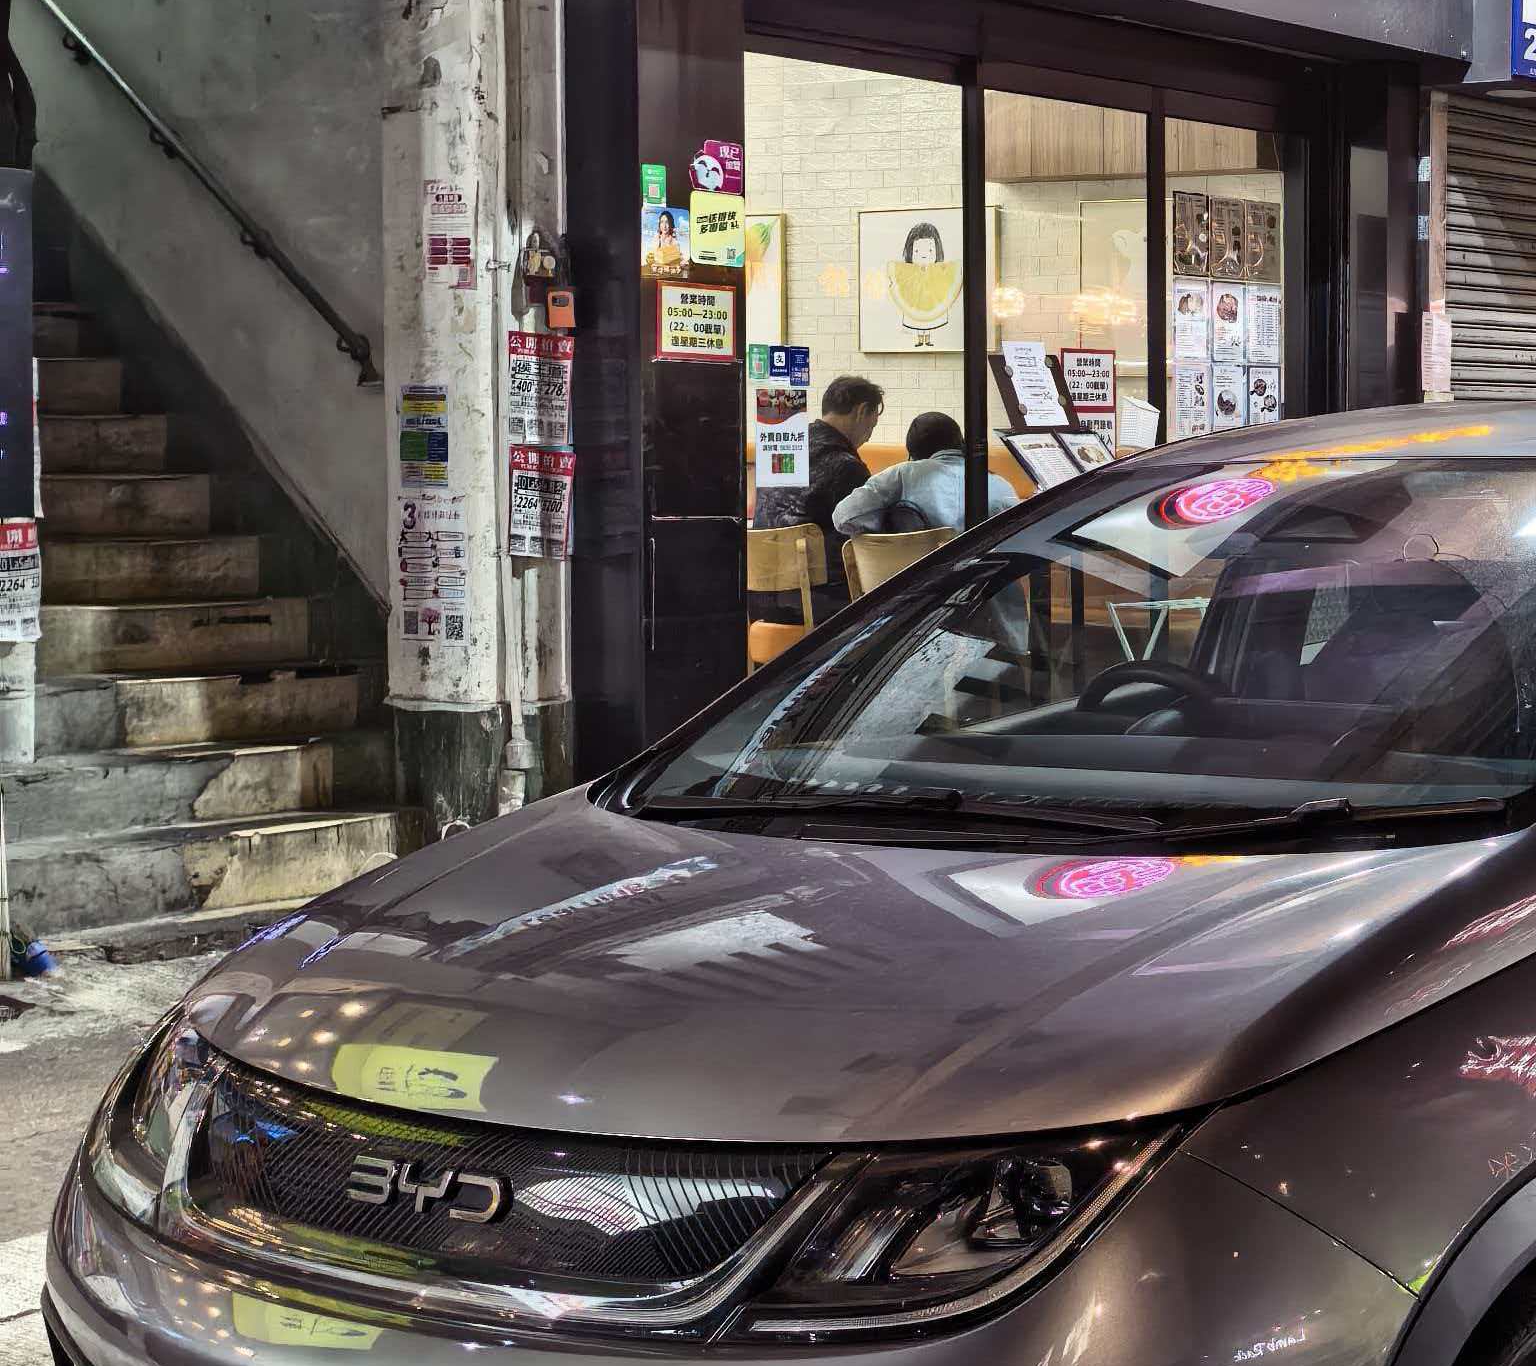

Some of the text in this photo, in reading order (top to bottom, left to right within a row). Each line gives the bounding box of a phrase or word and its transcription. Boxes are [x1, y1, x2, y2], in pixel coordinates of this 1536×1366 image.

[680, 293, 716, 306] 營業時間
[348, 1154, 502, 1223] BYD
